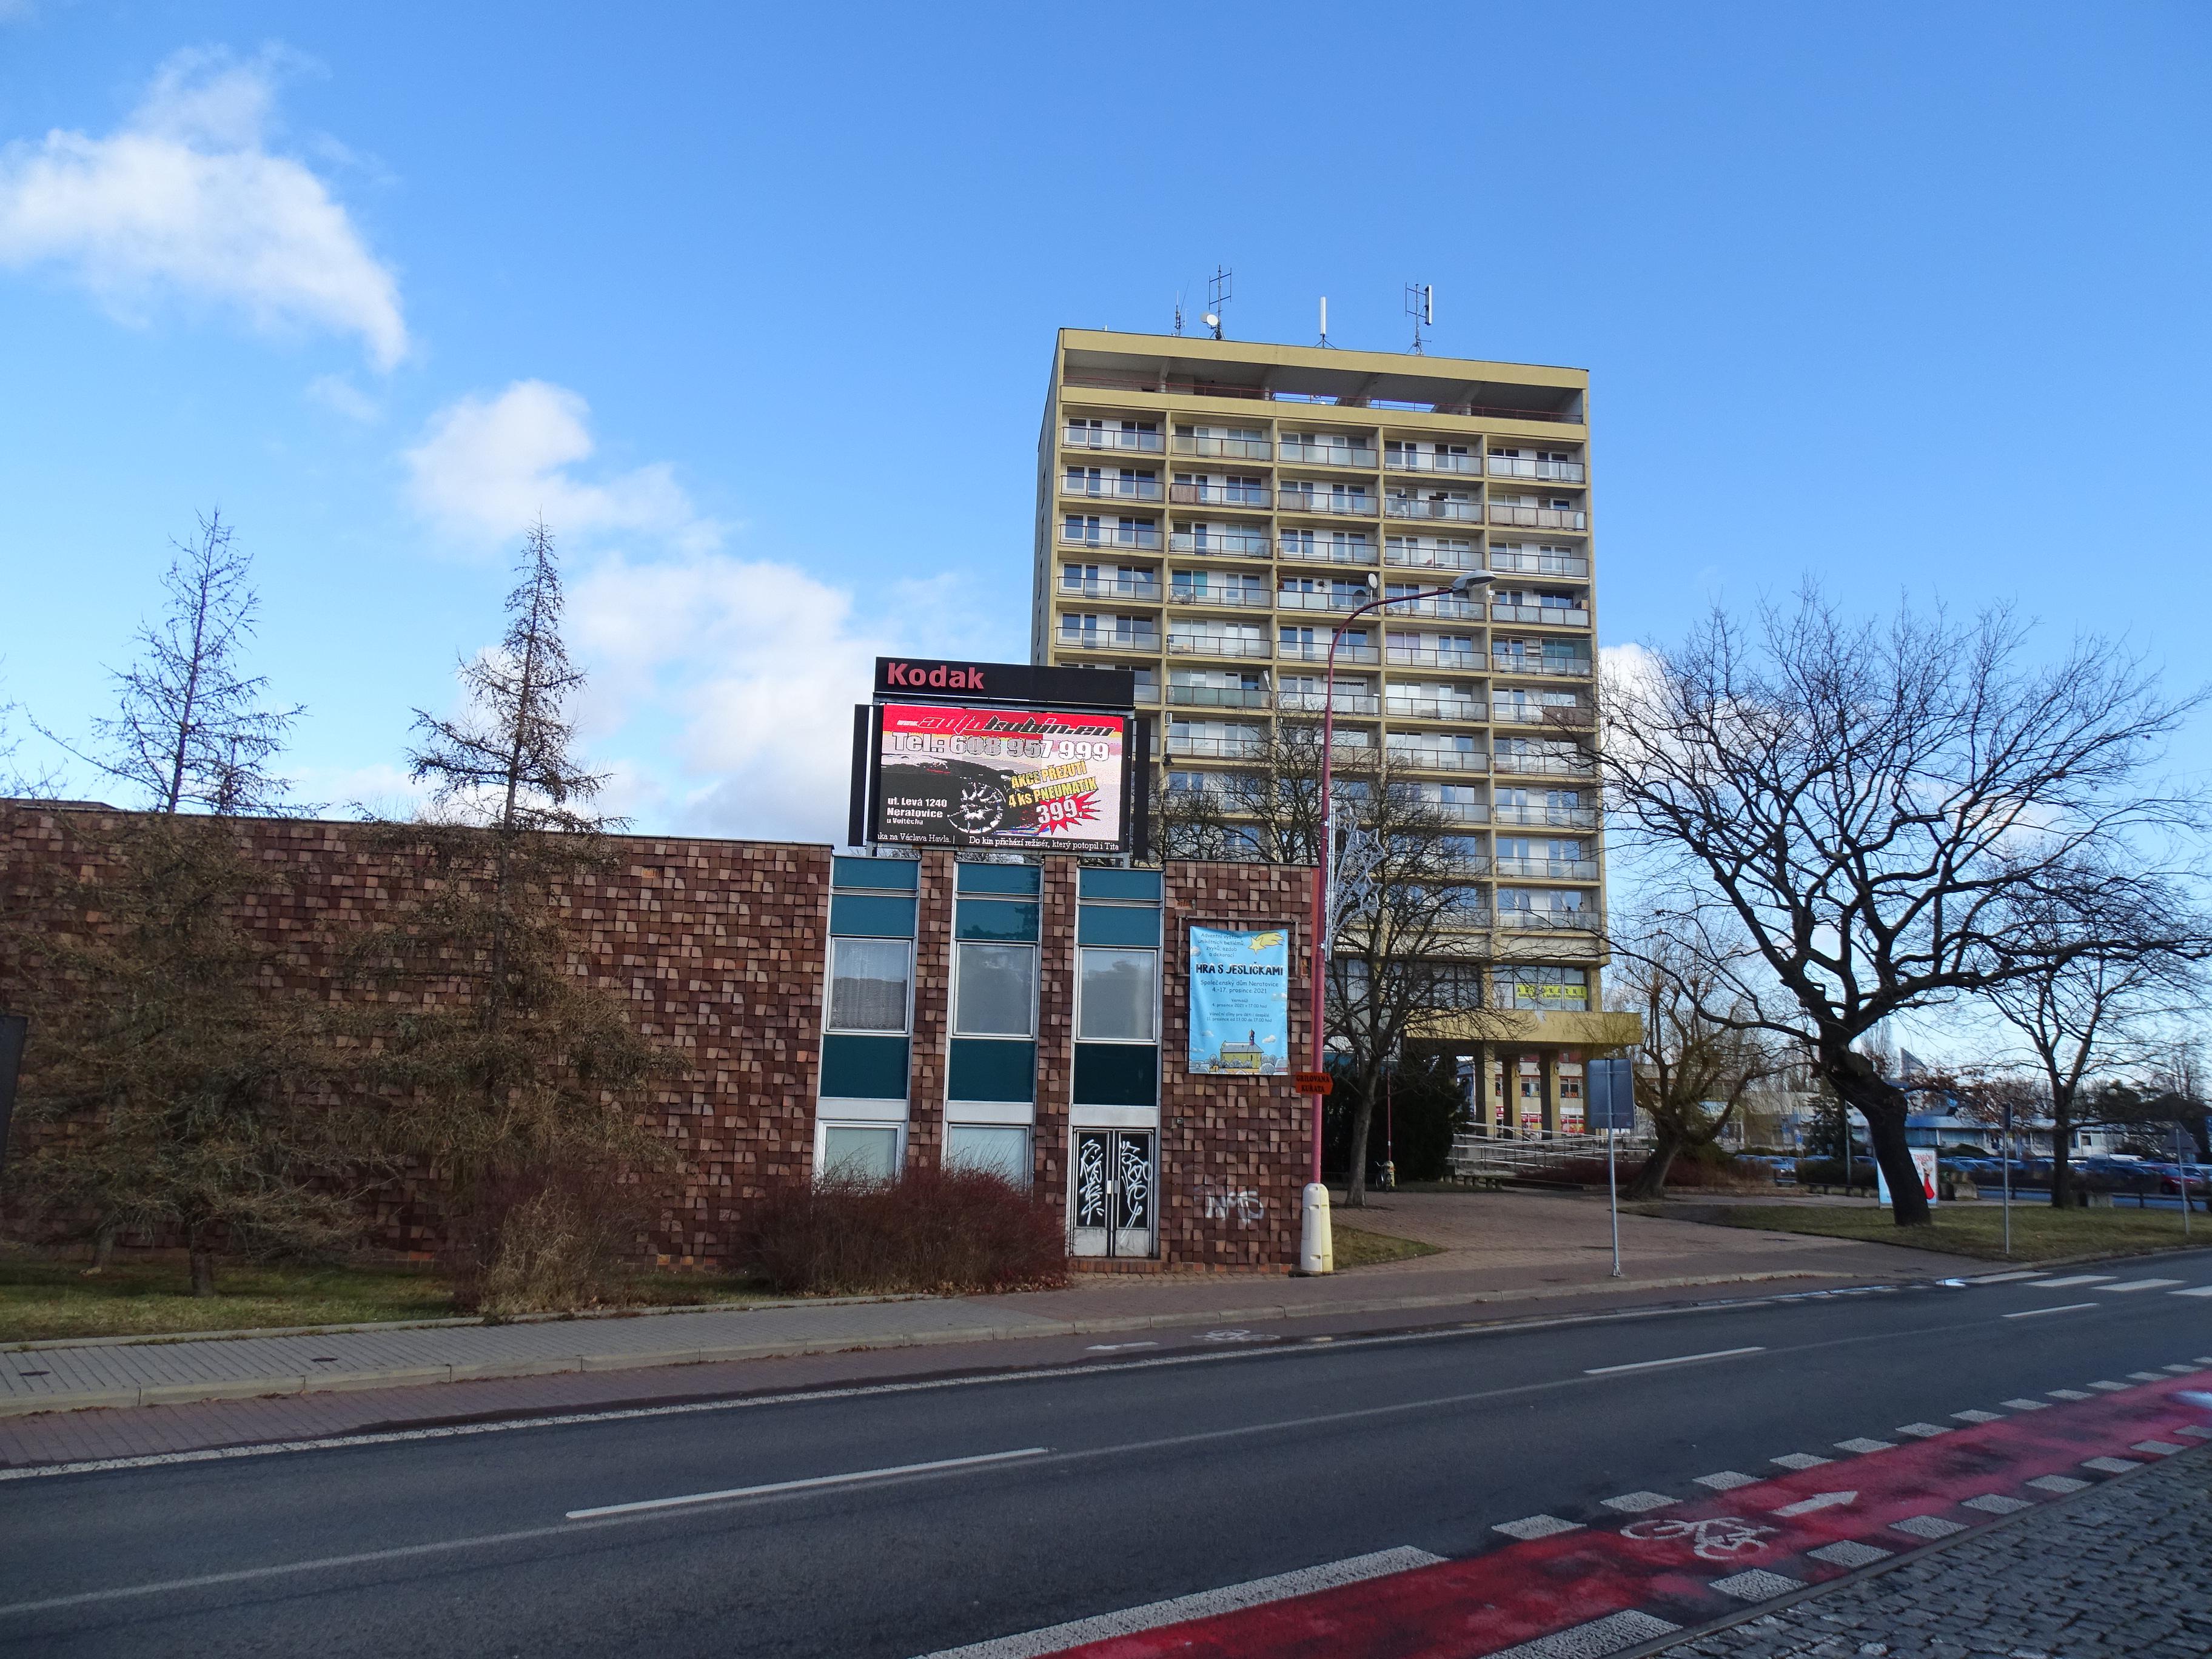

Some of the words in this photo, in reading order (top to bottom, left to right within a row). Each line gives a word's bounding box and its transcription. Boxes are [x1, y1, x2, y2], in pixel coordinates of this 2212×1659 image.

[888, 662, 984, 689] Kodak
[892, 731, 945, 753] Tel.:
[950, 734, 1001, 756] 608
[1007, 738, 1053, 759] 957
[1059, 740, 1110, 762] 999
[1011, 771, 1042, 789] AKCE
[1008, 794, 1016, 807] 4
[1033, 777, 1099, 803] PNEUMATIK
[901, 797, 922, 806] Levá
[925, 799, 947, 808] 1240
[886, 807, 943, 818] Neratovice
[900, 833, 927, 842] Václava
[928, 834, 951, 843] Havla.
[968, 836, 980, 845] Do
[982, 836, 993, 845] kin
[994, 837, 1024, 848] přichází
[1025, 839, 1050, 848] režisér,
[1052, 839, 1071, 850] který
[1072, 841, 1099, 851] potopil
[1104, 842, 1119, 851] Tita
[1196, 964, 1216, 974] HRA
[1218, 964, 1224, 974] S
[1225, 961, 1283, 976] JESLIČKAMI
[1296, 1073, 1329, 1082] GRILOVANÁ
[1301, 1084, 1324, 1093] KUŘATA
